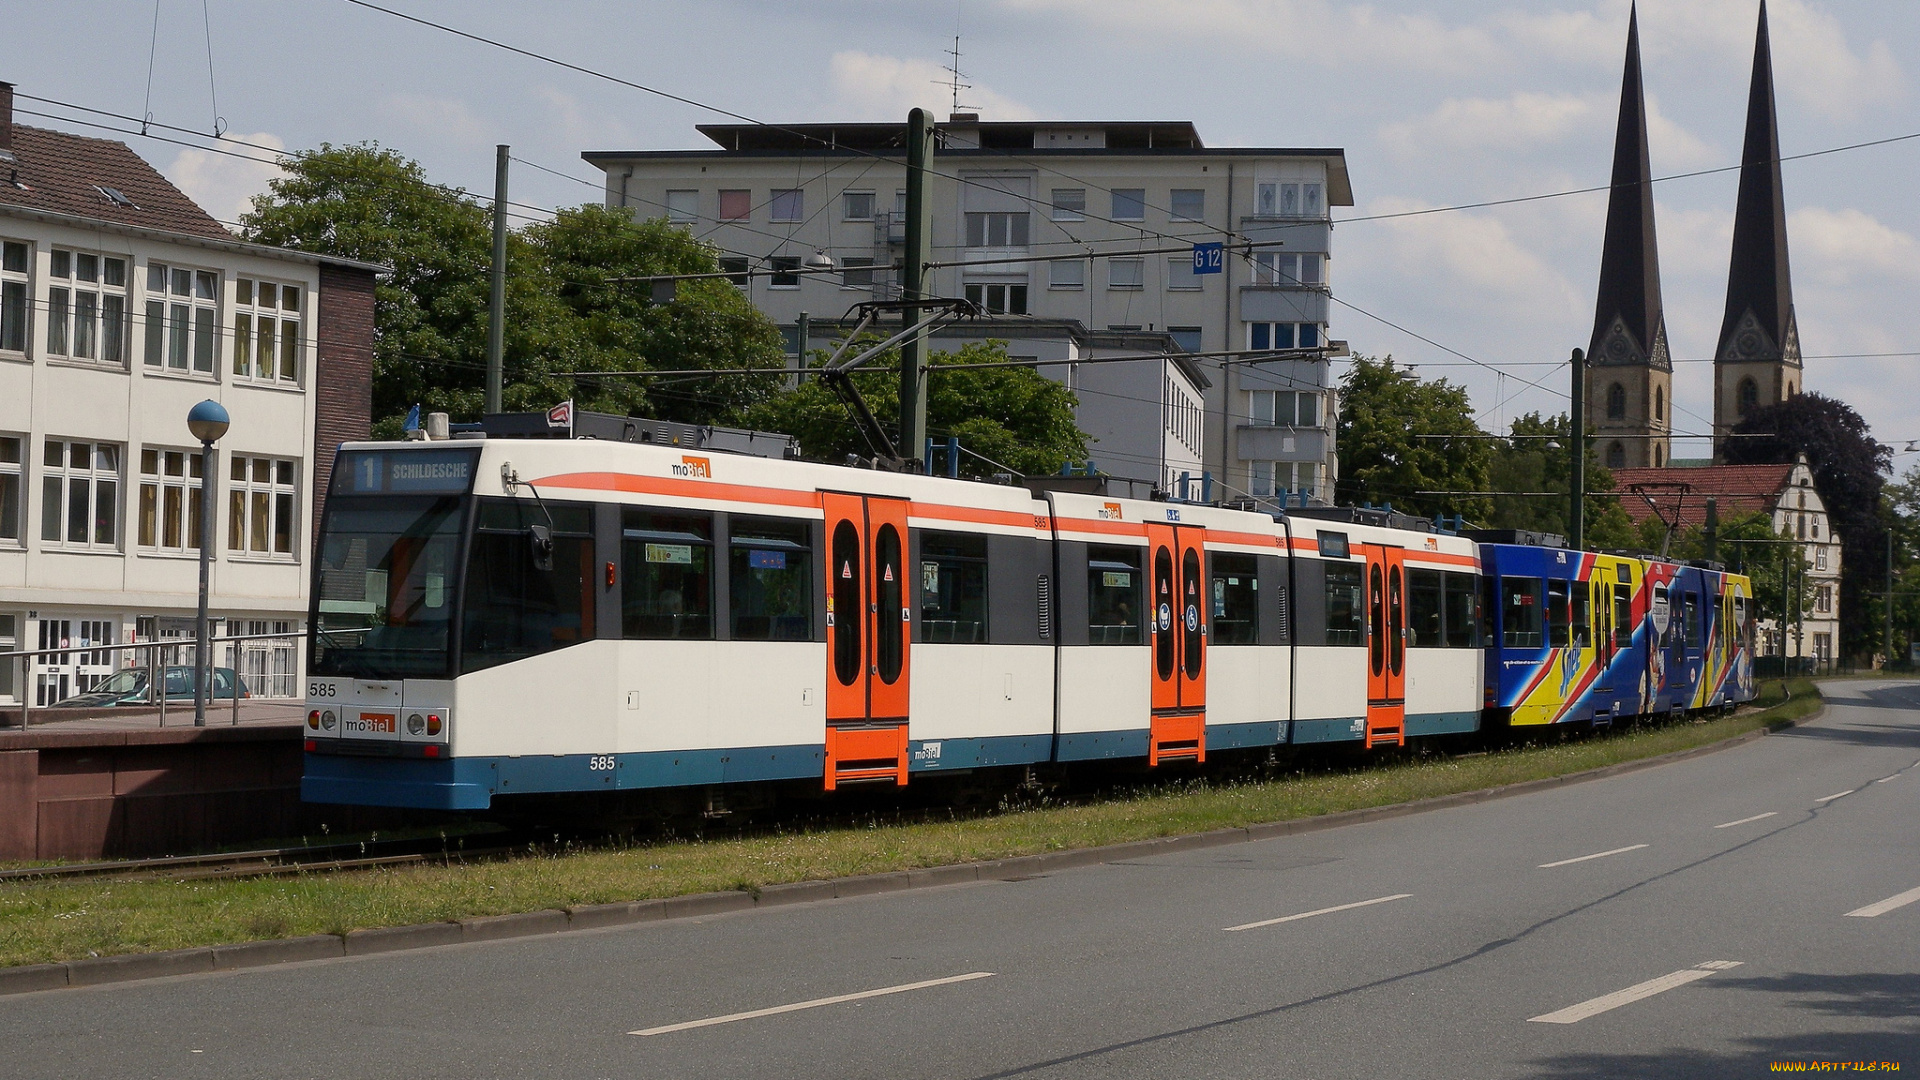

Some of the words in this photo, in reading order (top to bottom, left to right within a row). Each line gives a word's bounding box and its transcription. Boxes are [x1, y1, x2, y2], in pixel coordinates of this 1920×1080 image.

[1195, 250, 1204, 268] G
[1206, 248, 1221, 267] 12
[363, 457, 374, 488] 1
[393, 462, 468, 479] SCHILDESCHE
[671, 461, 708, 478] moBiel
[1034, 517, 1047, 528] 585
[309, 683, 336, 698] 585
[345, 714, 390, 733] moBiel
[589, 756, 616, 771] 585
